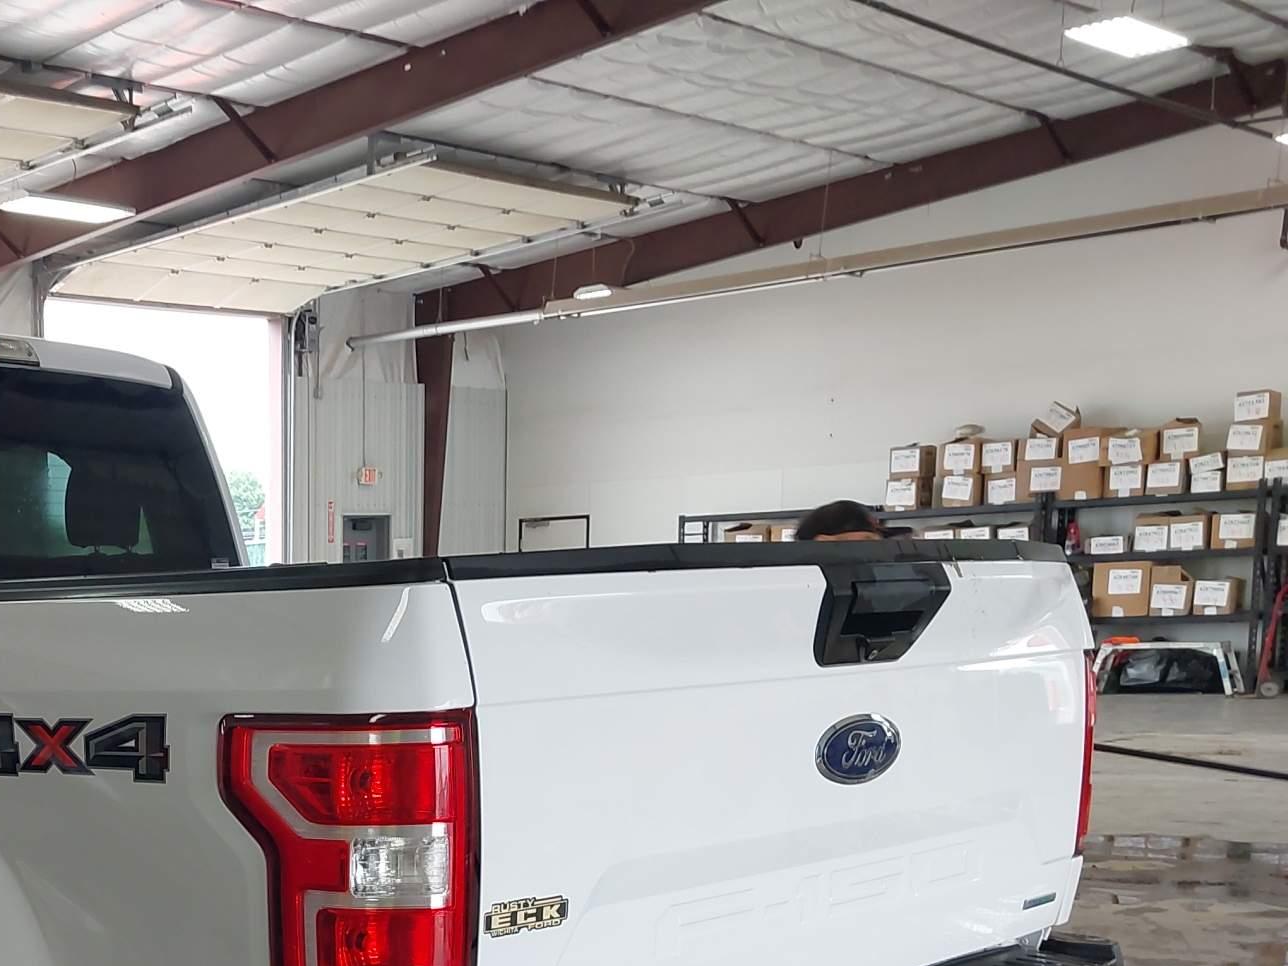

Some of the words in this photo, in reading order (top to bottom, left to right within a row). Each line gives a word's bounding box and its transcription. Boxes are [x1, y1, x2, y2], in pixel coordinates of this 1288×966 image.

[841, 729, 895, 769] Ford
[490, 904, 561, 929] ECK
[492, 899, 535, 914] RUSTY
[491, 927, 519, 937] WICHITA
[527, 919, 561, 930] FORD
